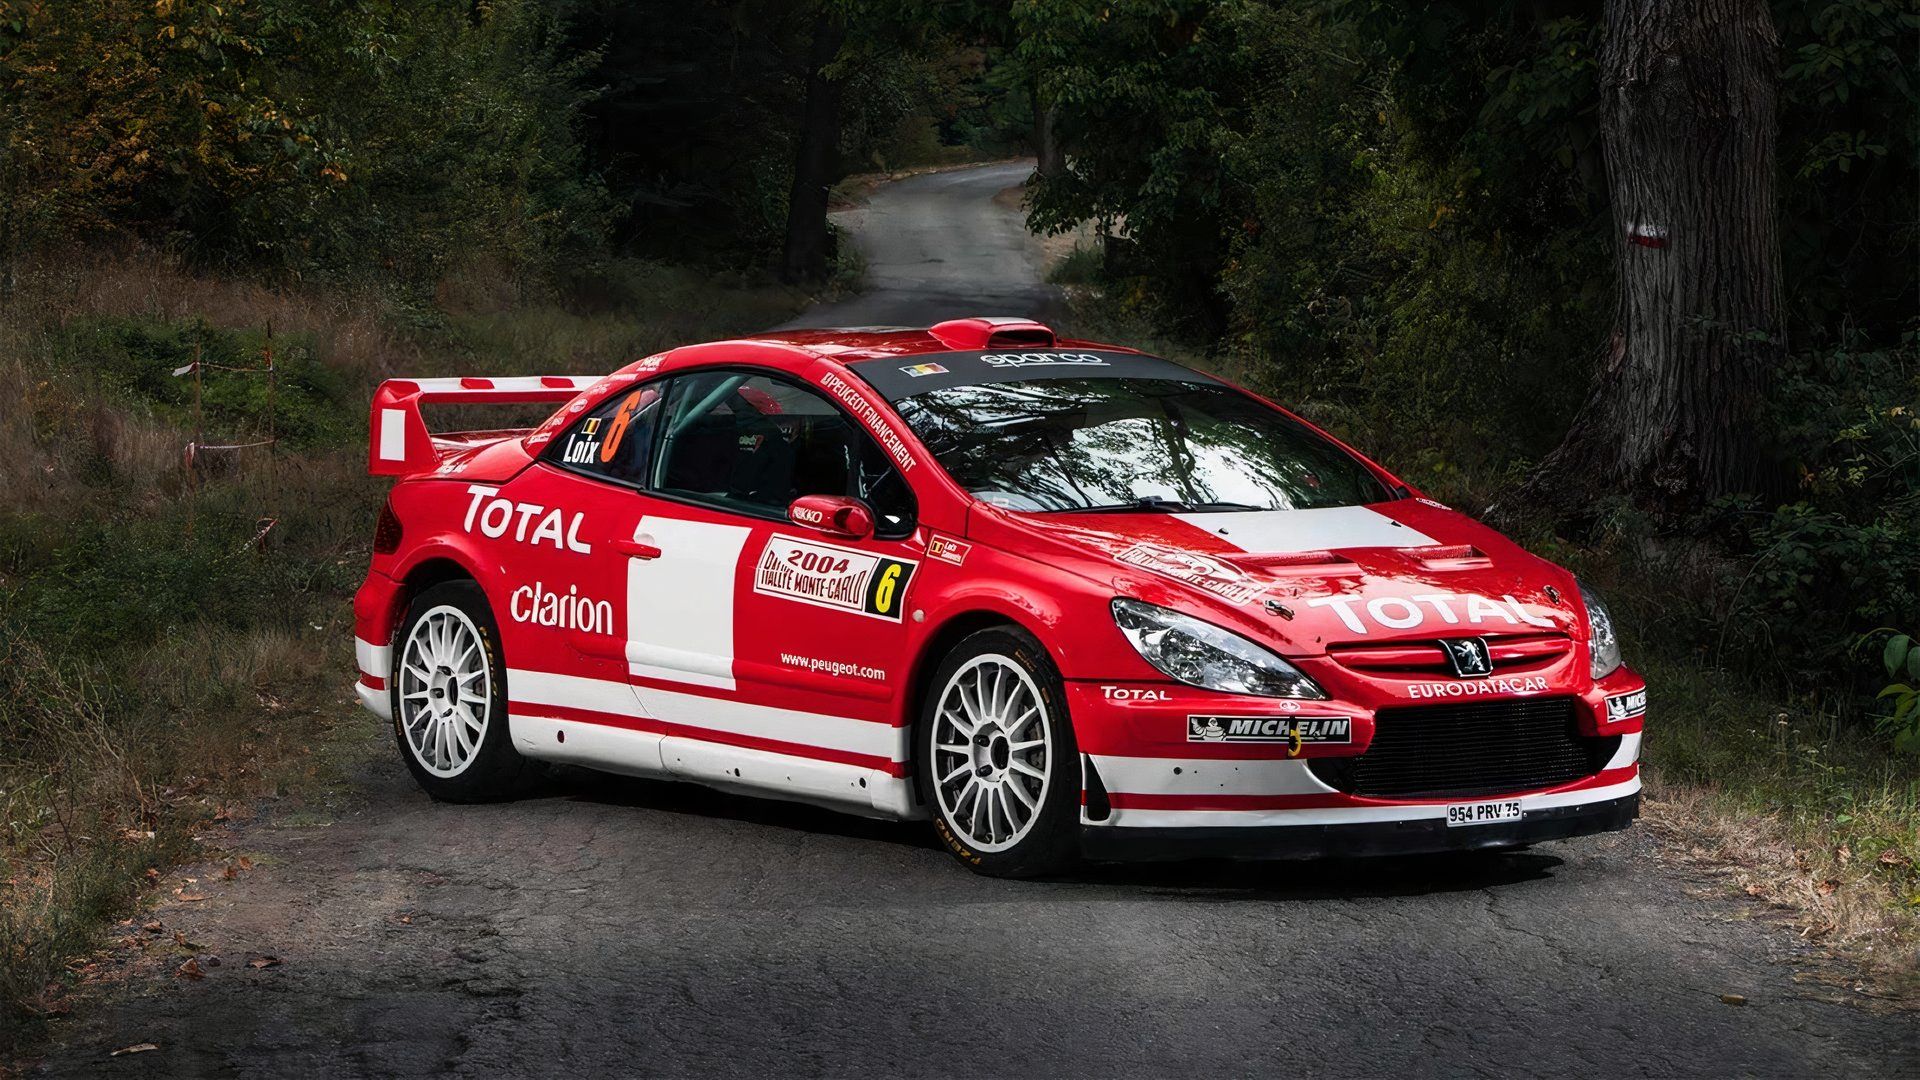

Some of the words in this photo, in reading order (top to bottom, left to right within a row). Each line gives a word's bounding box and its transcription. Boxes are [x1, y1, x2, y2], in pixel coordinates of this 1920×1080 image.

[980, 353, 1111, 368] sparco
[601, 389, 641, 463] 6
[827, 376, 869, 413] PEUGEOT
[862, 407, 916, 472] FINANCEMENT
[563, 433, 599, 464] Loix
[463, 485, 592, 554] TOTAL
[788, 549, 850, 574] 2004
[794, 570, 867, 604] MONTE-CARLO
[875, 563, 902, 613] 6
[1306, 594, 1556, 634] TOTAL
[781, 653, 885, 680] www.peugeot.com
[1101, 686, 1173, 700] TOTAL
[1408, 676, 1549, 699] EURODATACAR
[1228, 719, 1348, 736] MICHELIN
[1449, 806, 1473, 822] 954
[1477, 804, 1502, 820] PRV
[1505, 802, 1520, 818] 75
